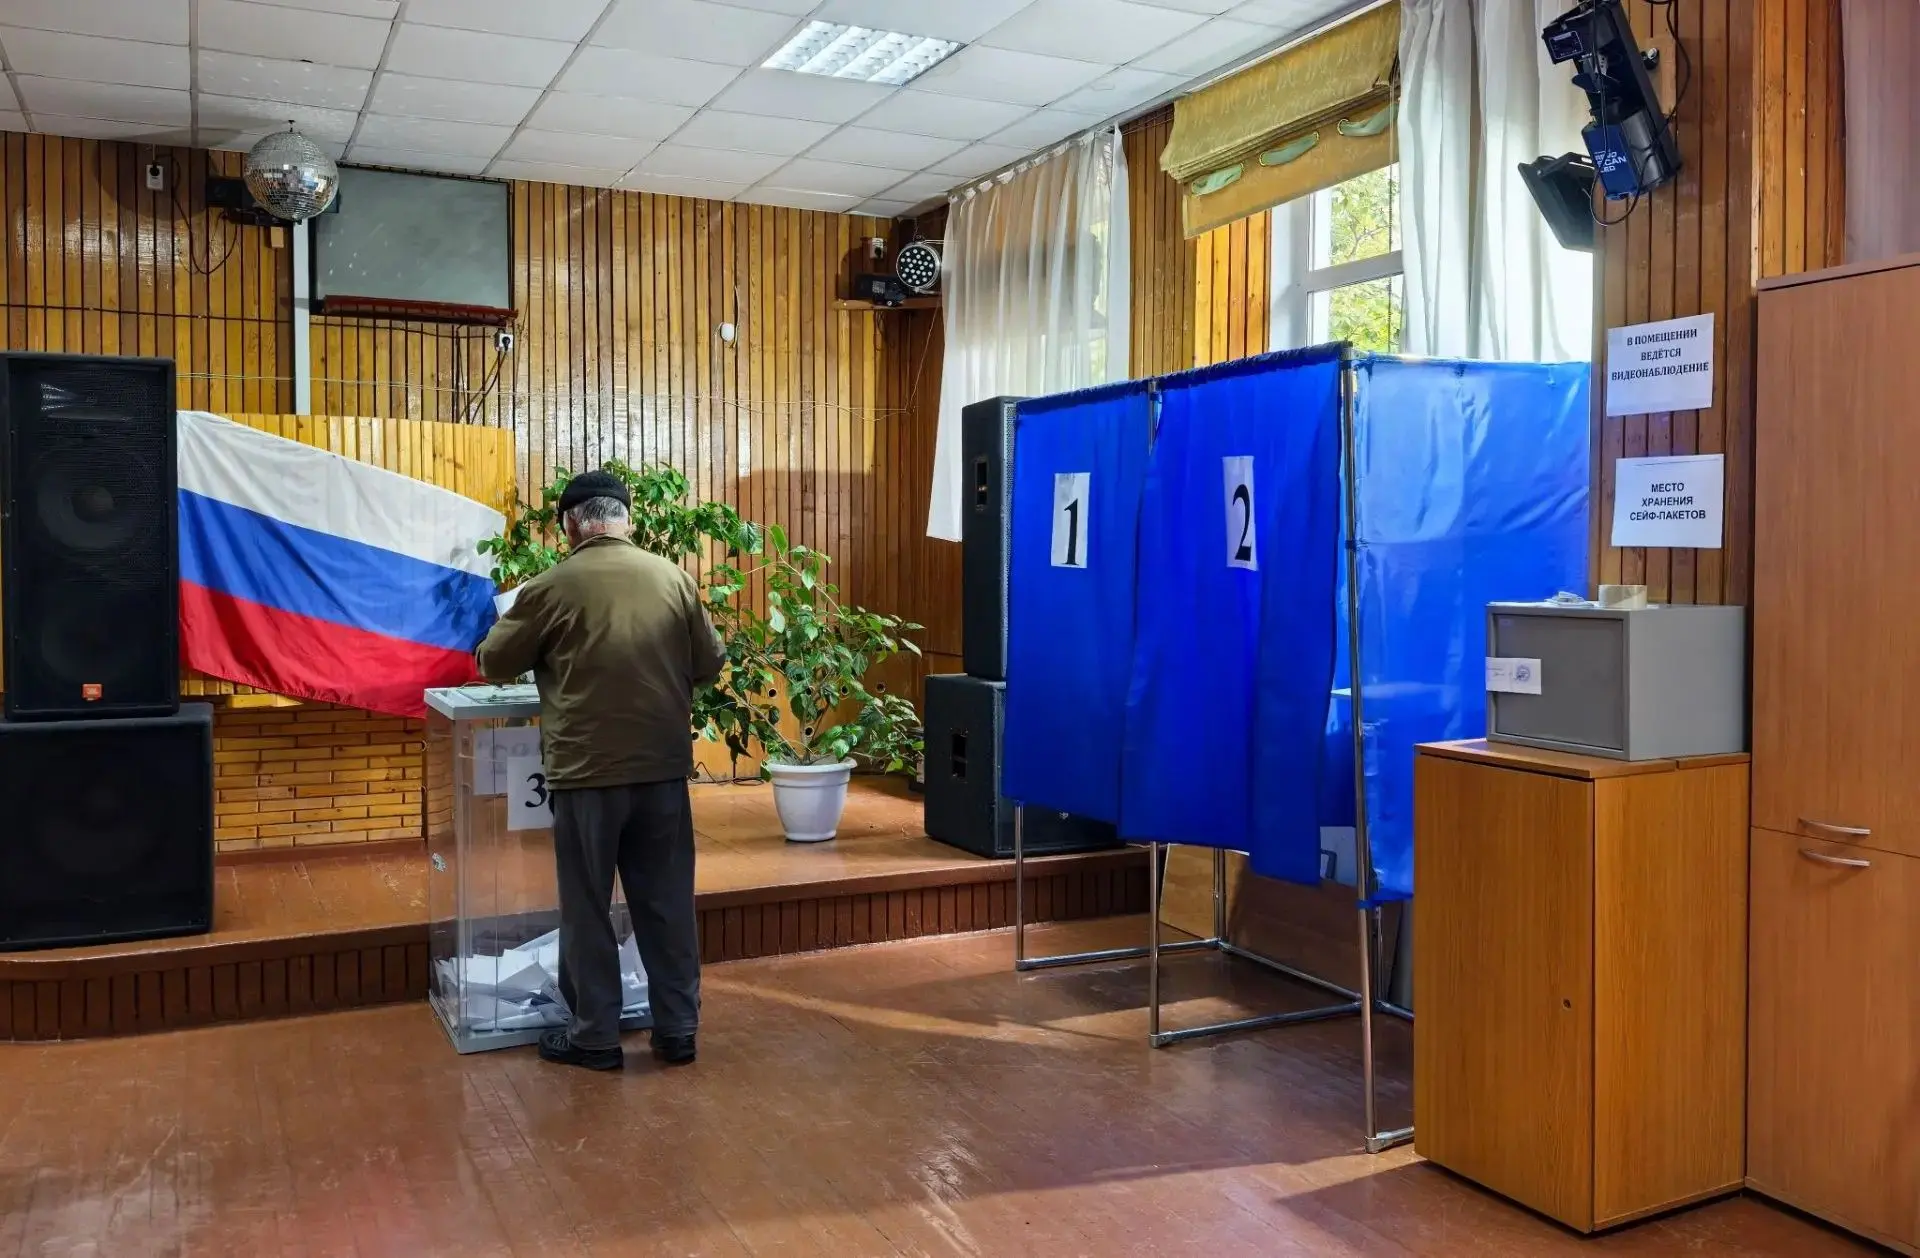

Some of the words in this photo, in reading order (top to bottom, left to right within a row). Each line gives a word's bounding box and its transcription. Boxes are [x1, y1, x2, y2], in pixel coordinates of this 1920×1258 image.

[1627, 337, 1633, 346] В
[1634, 328, 1697, 345] ПОМЕЩЕНИИ
[1640, 348, 1681, 361] ВЕДЁТСЯ
[1611, 362, 1709, 381] ВИДЕОНАБЛЮДЕНИЕ
[1651, 482, 1685, 493] МЕСТО
[1641, 496, 1693, 507] ХРАНЕНИЯ
[1232, 484, 1252, 562] 2
[1629, 510, 1706, 521] СЕЙФ-ПАКЕТОВ
[1062, 498, 1079, 565] 1
